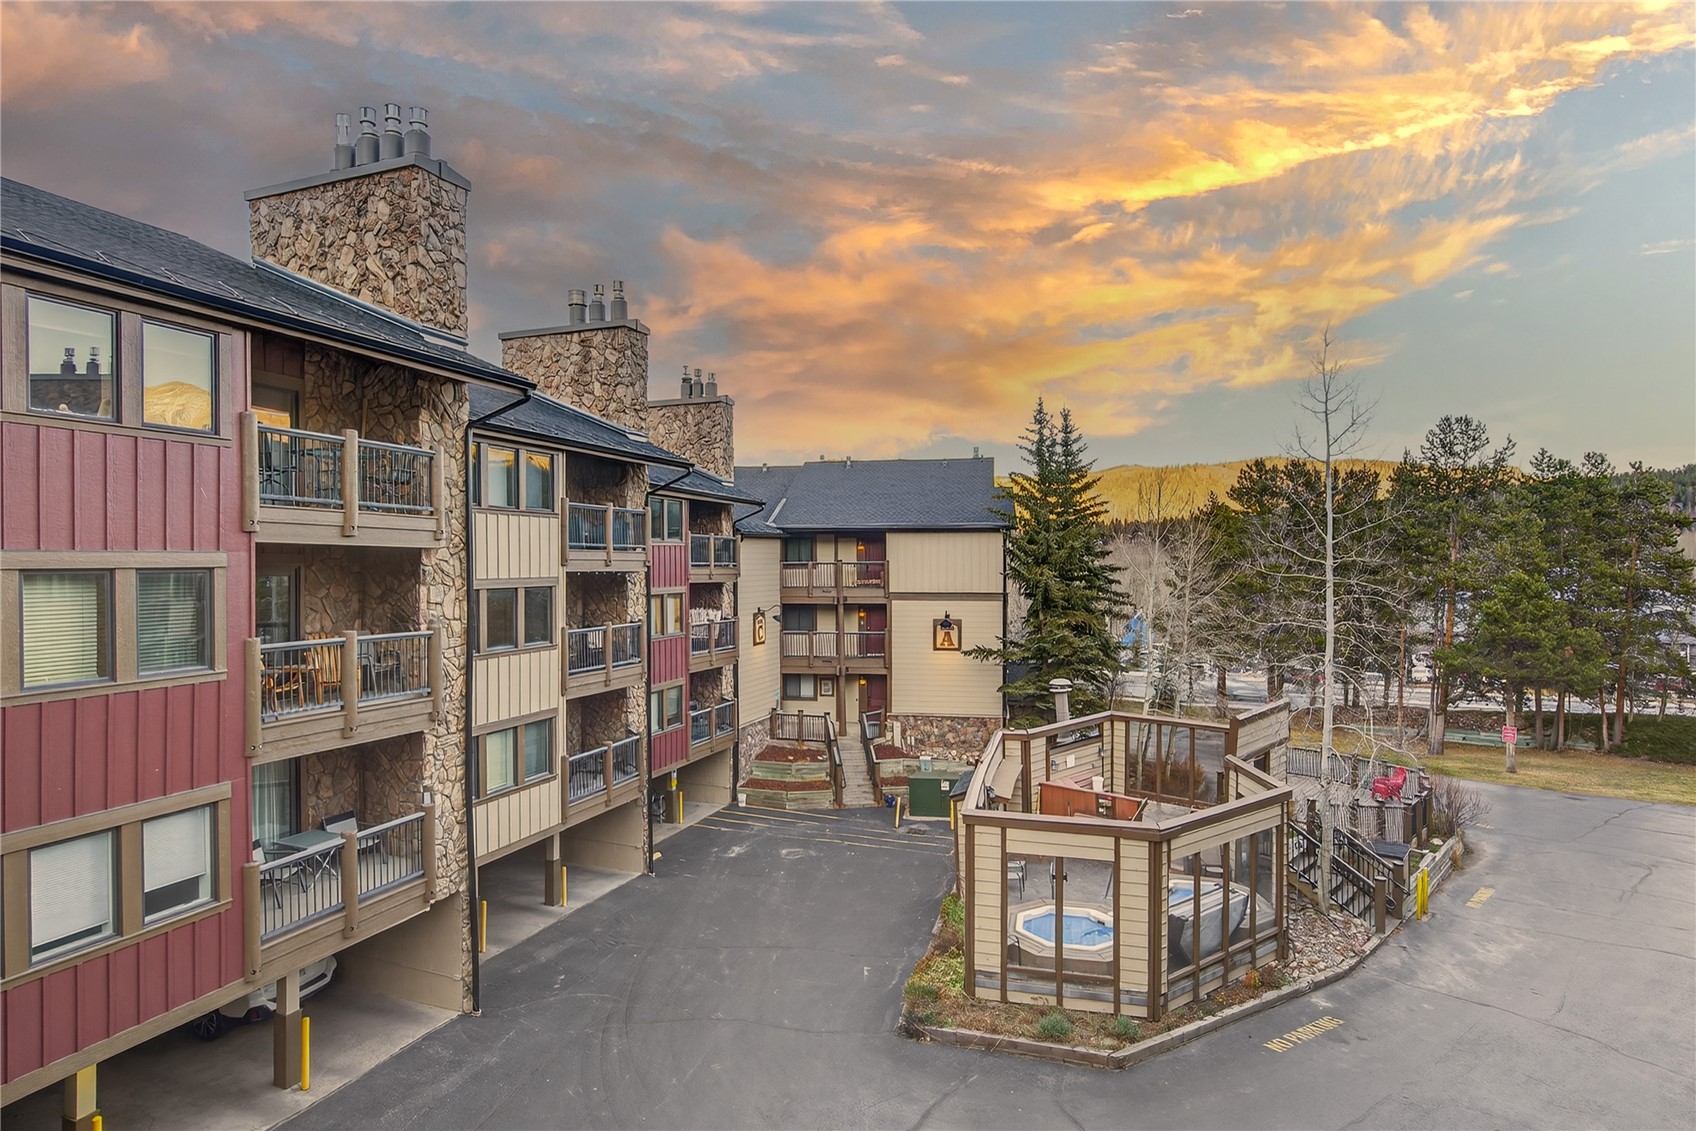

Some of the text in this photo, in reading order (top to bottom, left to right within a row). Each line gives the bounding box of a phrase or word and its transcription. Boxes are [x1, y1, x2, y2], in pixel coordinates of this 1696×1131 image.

[757, 625, 764, 641] C
[940, 631, 956, 646] A
[1263, 1015, 1345, 1053] NO PARKING
